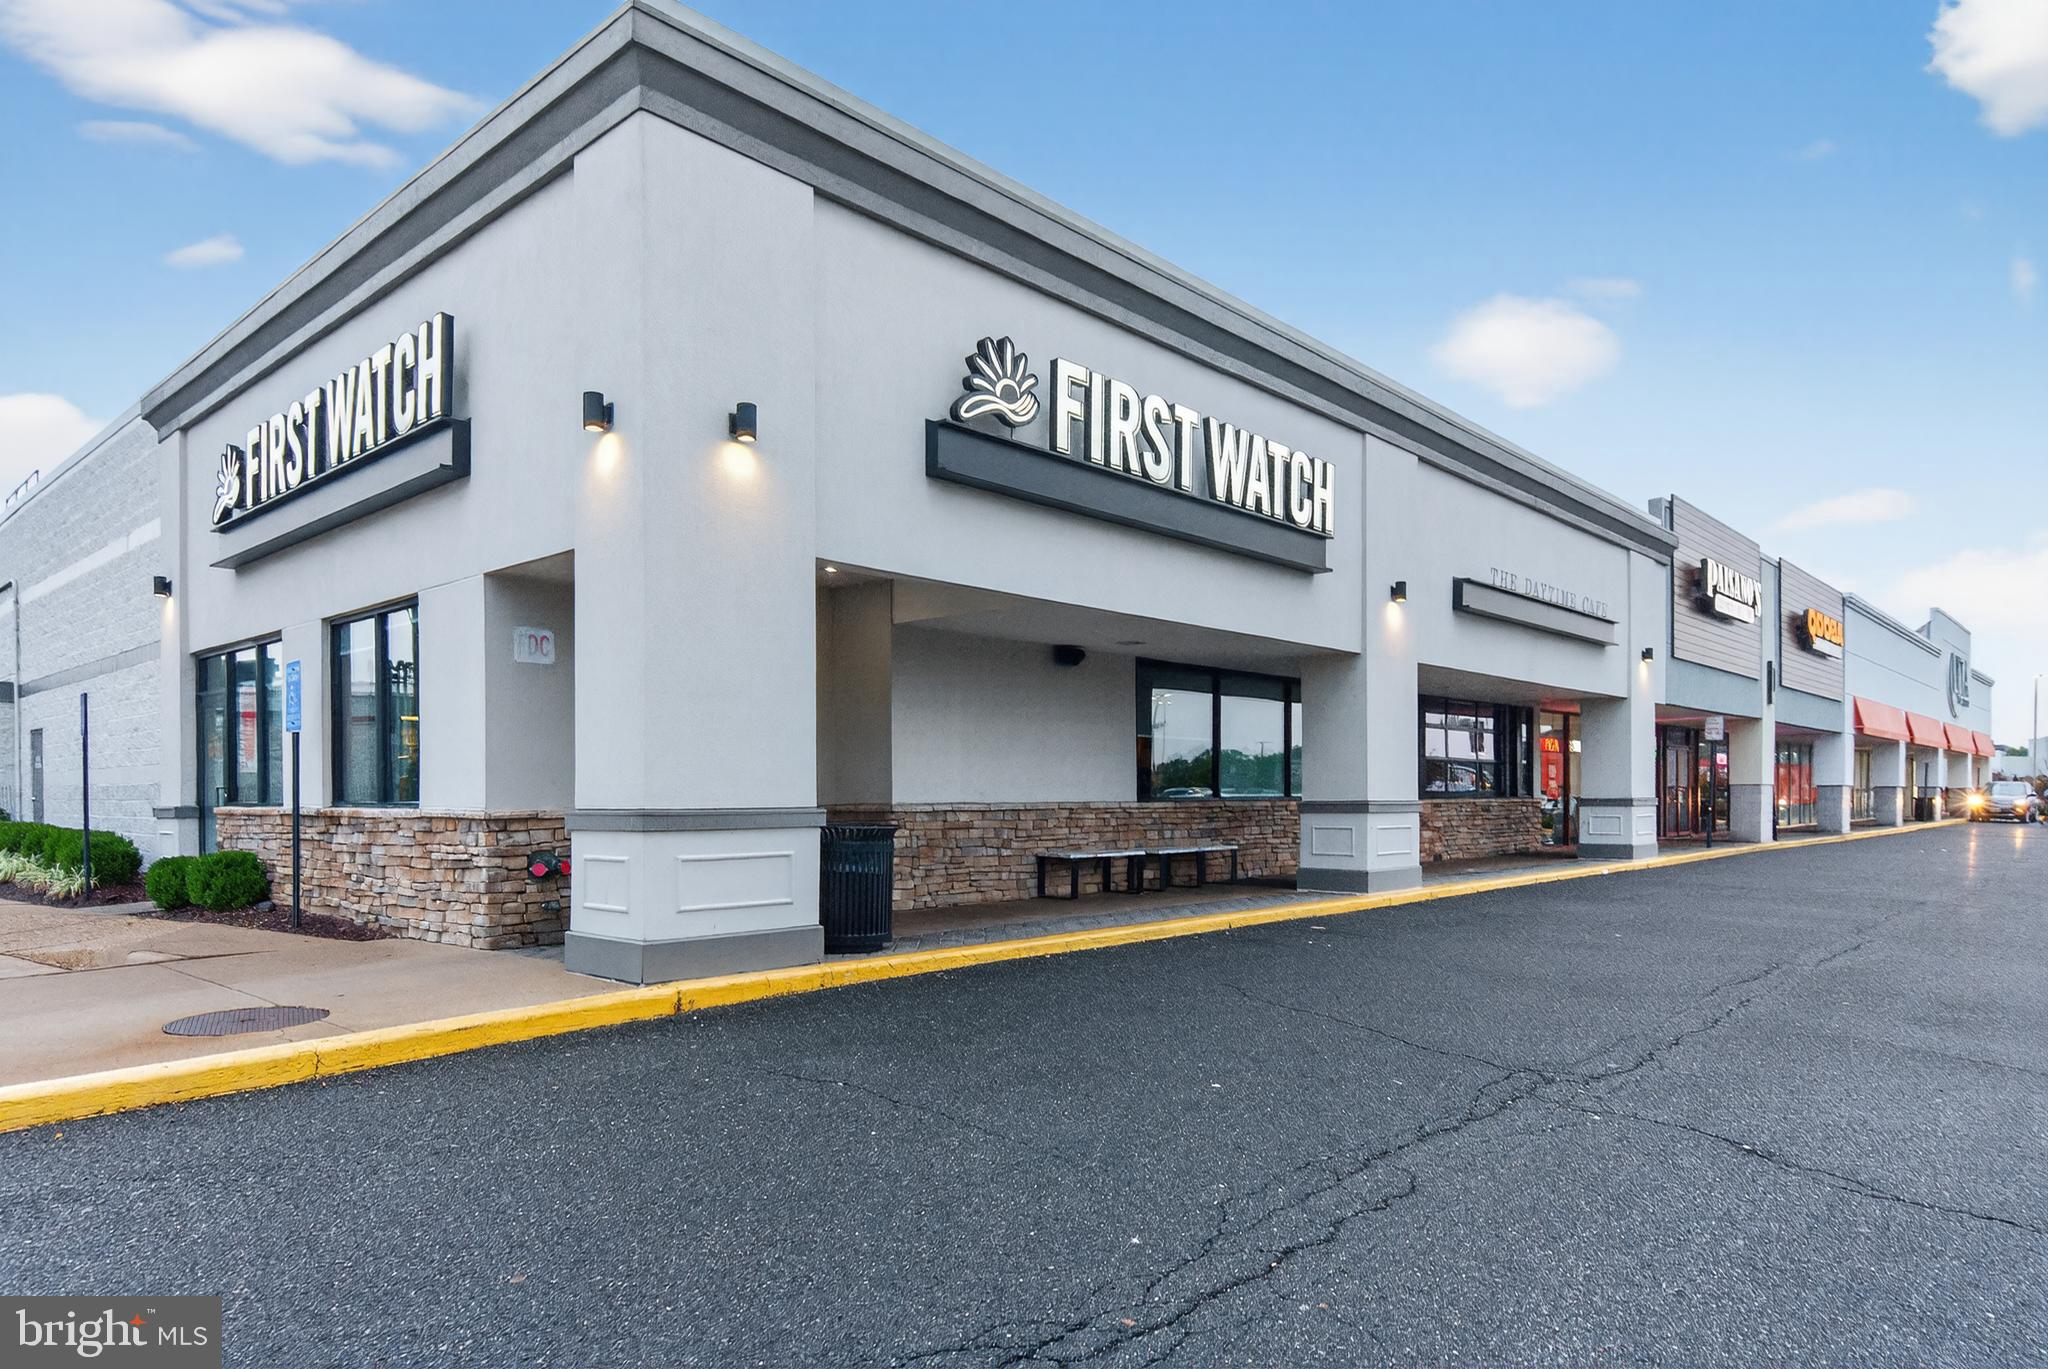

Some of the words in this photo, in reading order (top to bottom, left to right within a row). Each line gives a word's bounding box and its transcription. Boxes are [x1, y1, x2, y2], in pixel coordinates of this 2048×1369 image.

[246, 386, 323, 510] FIRST
[326, 312, 454, 468] WATCH
[1050, 357, 1200, 492] FIRST
[1204, 416, 1336, 536] WATCH
[1490, 567, 1517, 592] THE
[1525, 578, 1577, 609] DAYTIME
